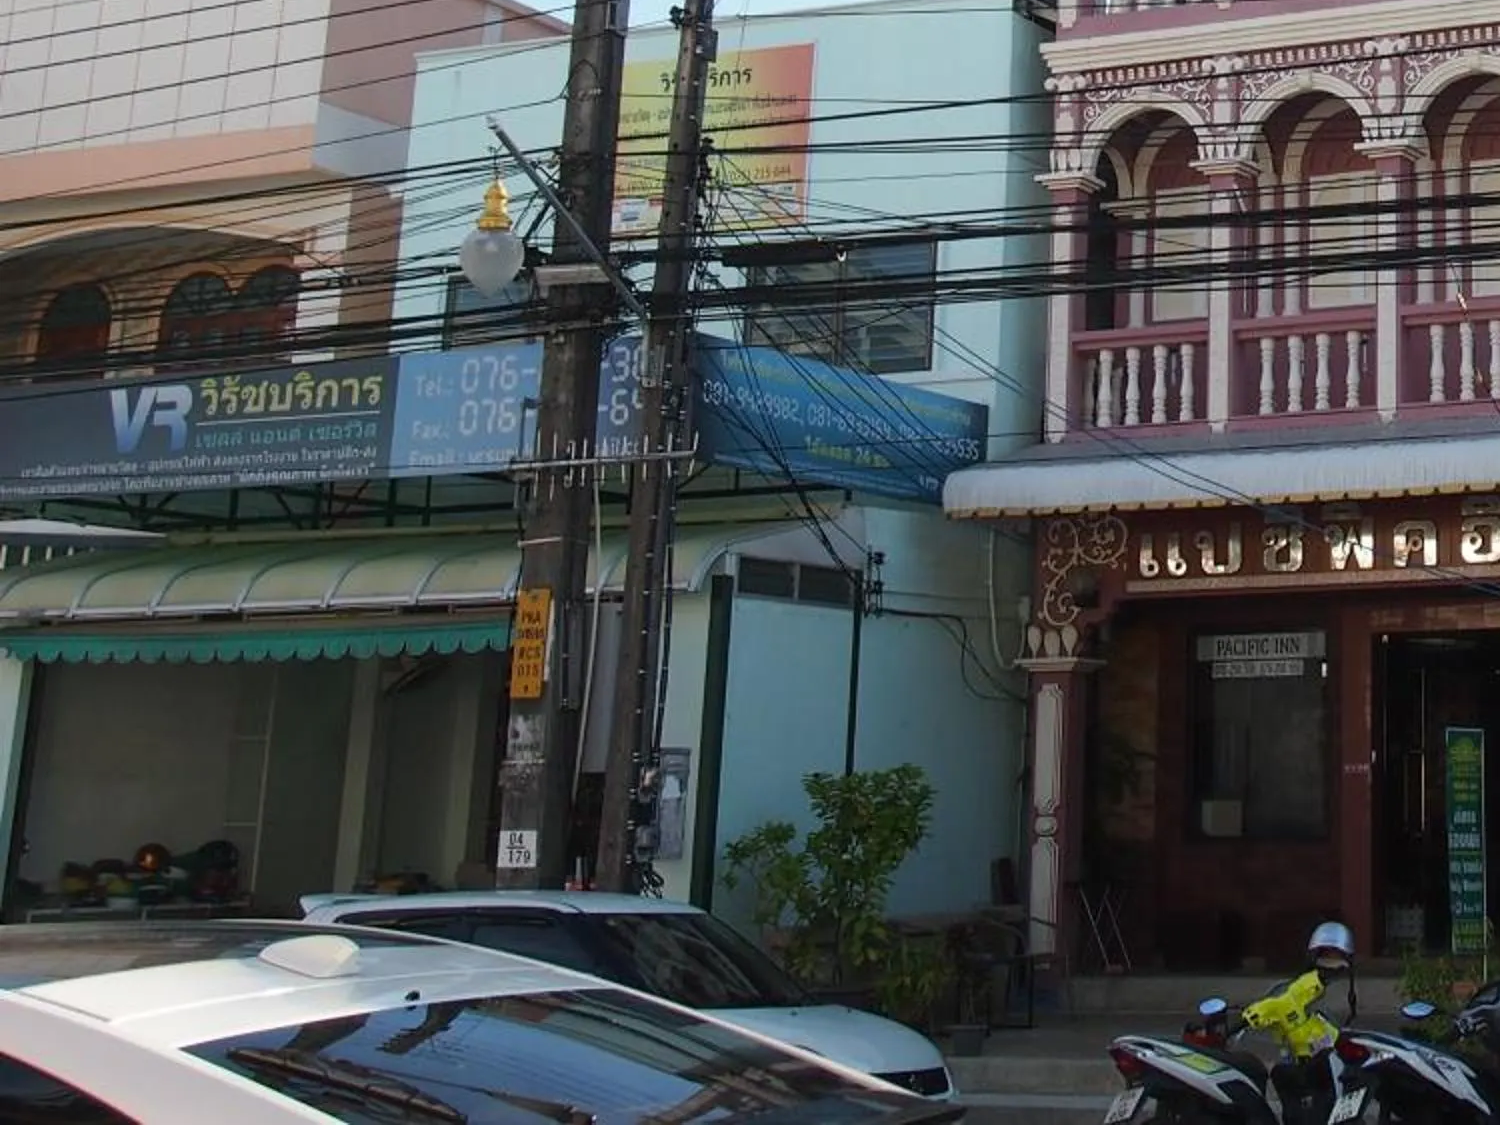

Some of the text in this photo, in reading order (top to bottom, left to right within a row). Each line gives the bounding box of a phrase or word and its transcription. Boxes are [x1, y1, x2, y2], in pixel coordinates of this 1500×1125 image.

[200, 371, 384, 417] วิรัชบริการ
[110, 384, 193, 454] VR
[1216, 636, 1300, 656] PACIFIC INN
[508, 850, 532, 865] 179
